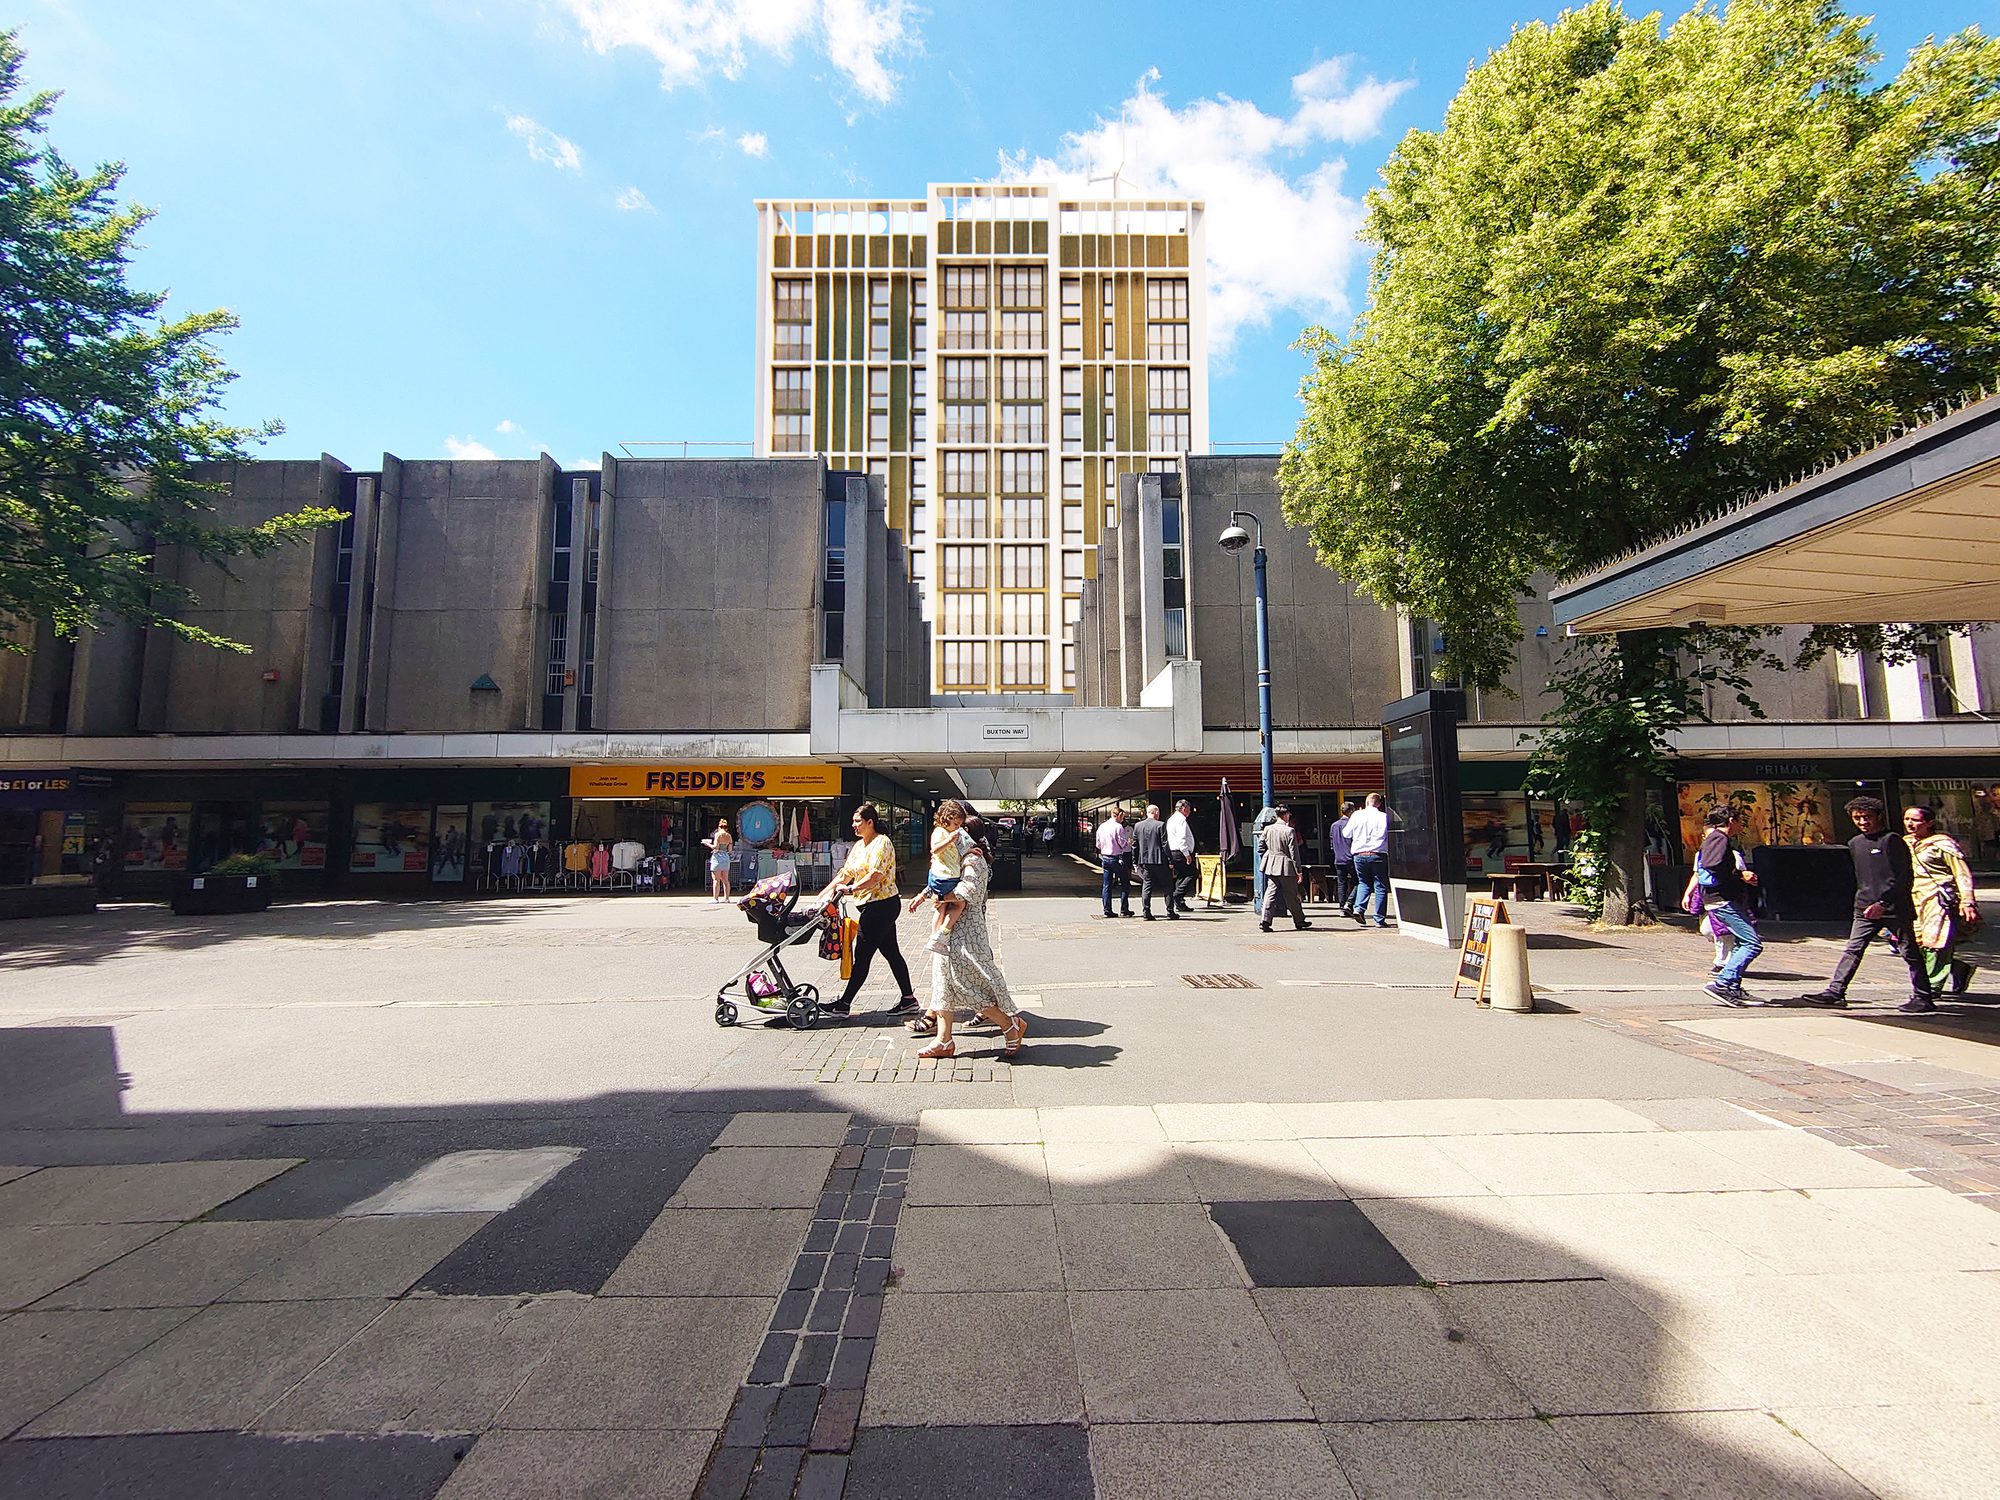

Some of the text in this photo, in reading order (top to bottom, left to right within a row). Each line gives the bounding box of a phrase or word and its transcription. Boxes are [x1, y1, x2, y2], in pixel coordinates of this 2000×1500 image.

[1273, 766, 1345, 785] reen Island
[1755, 764, 1819, 775] PRIMARK
[12, 780, 26, 790] £1
[27, 780, 42, 790] or
[645, 771, 766, 791] FREDDIE'S
